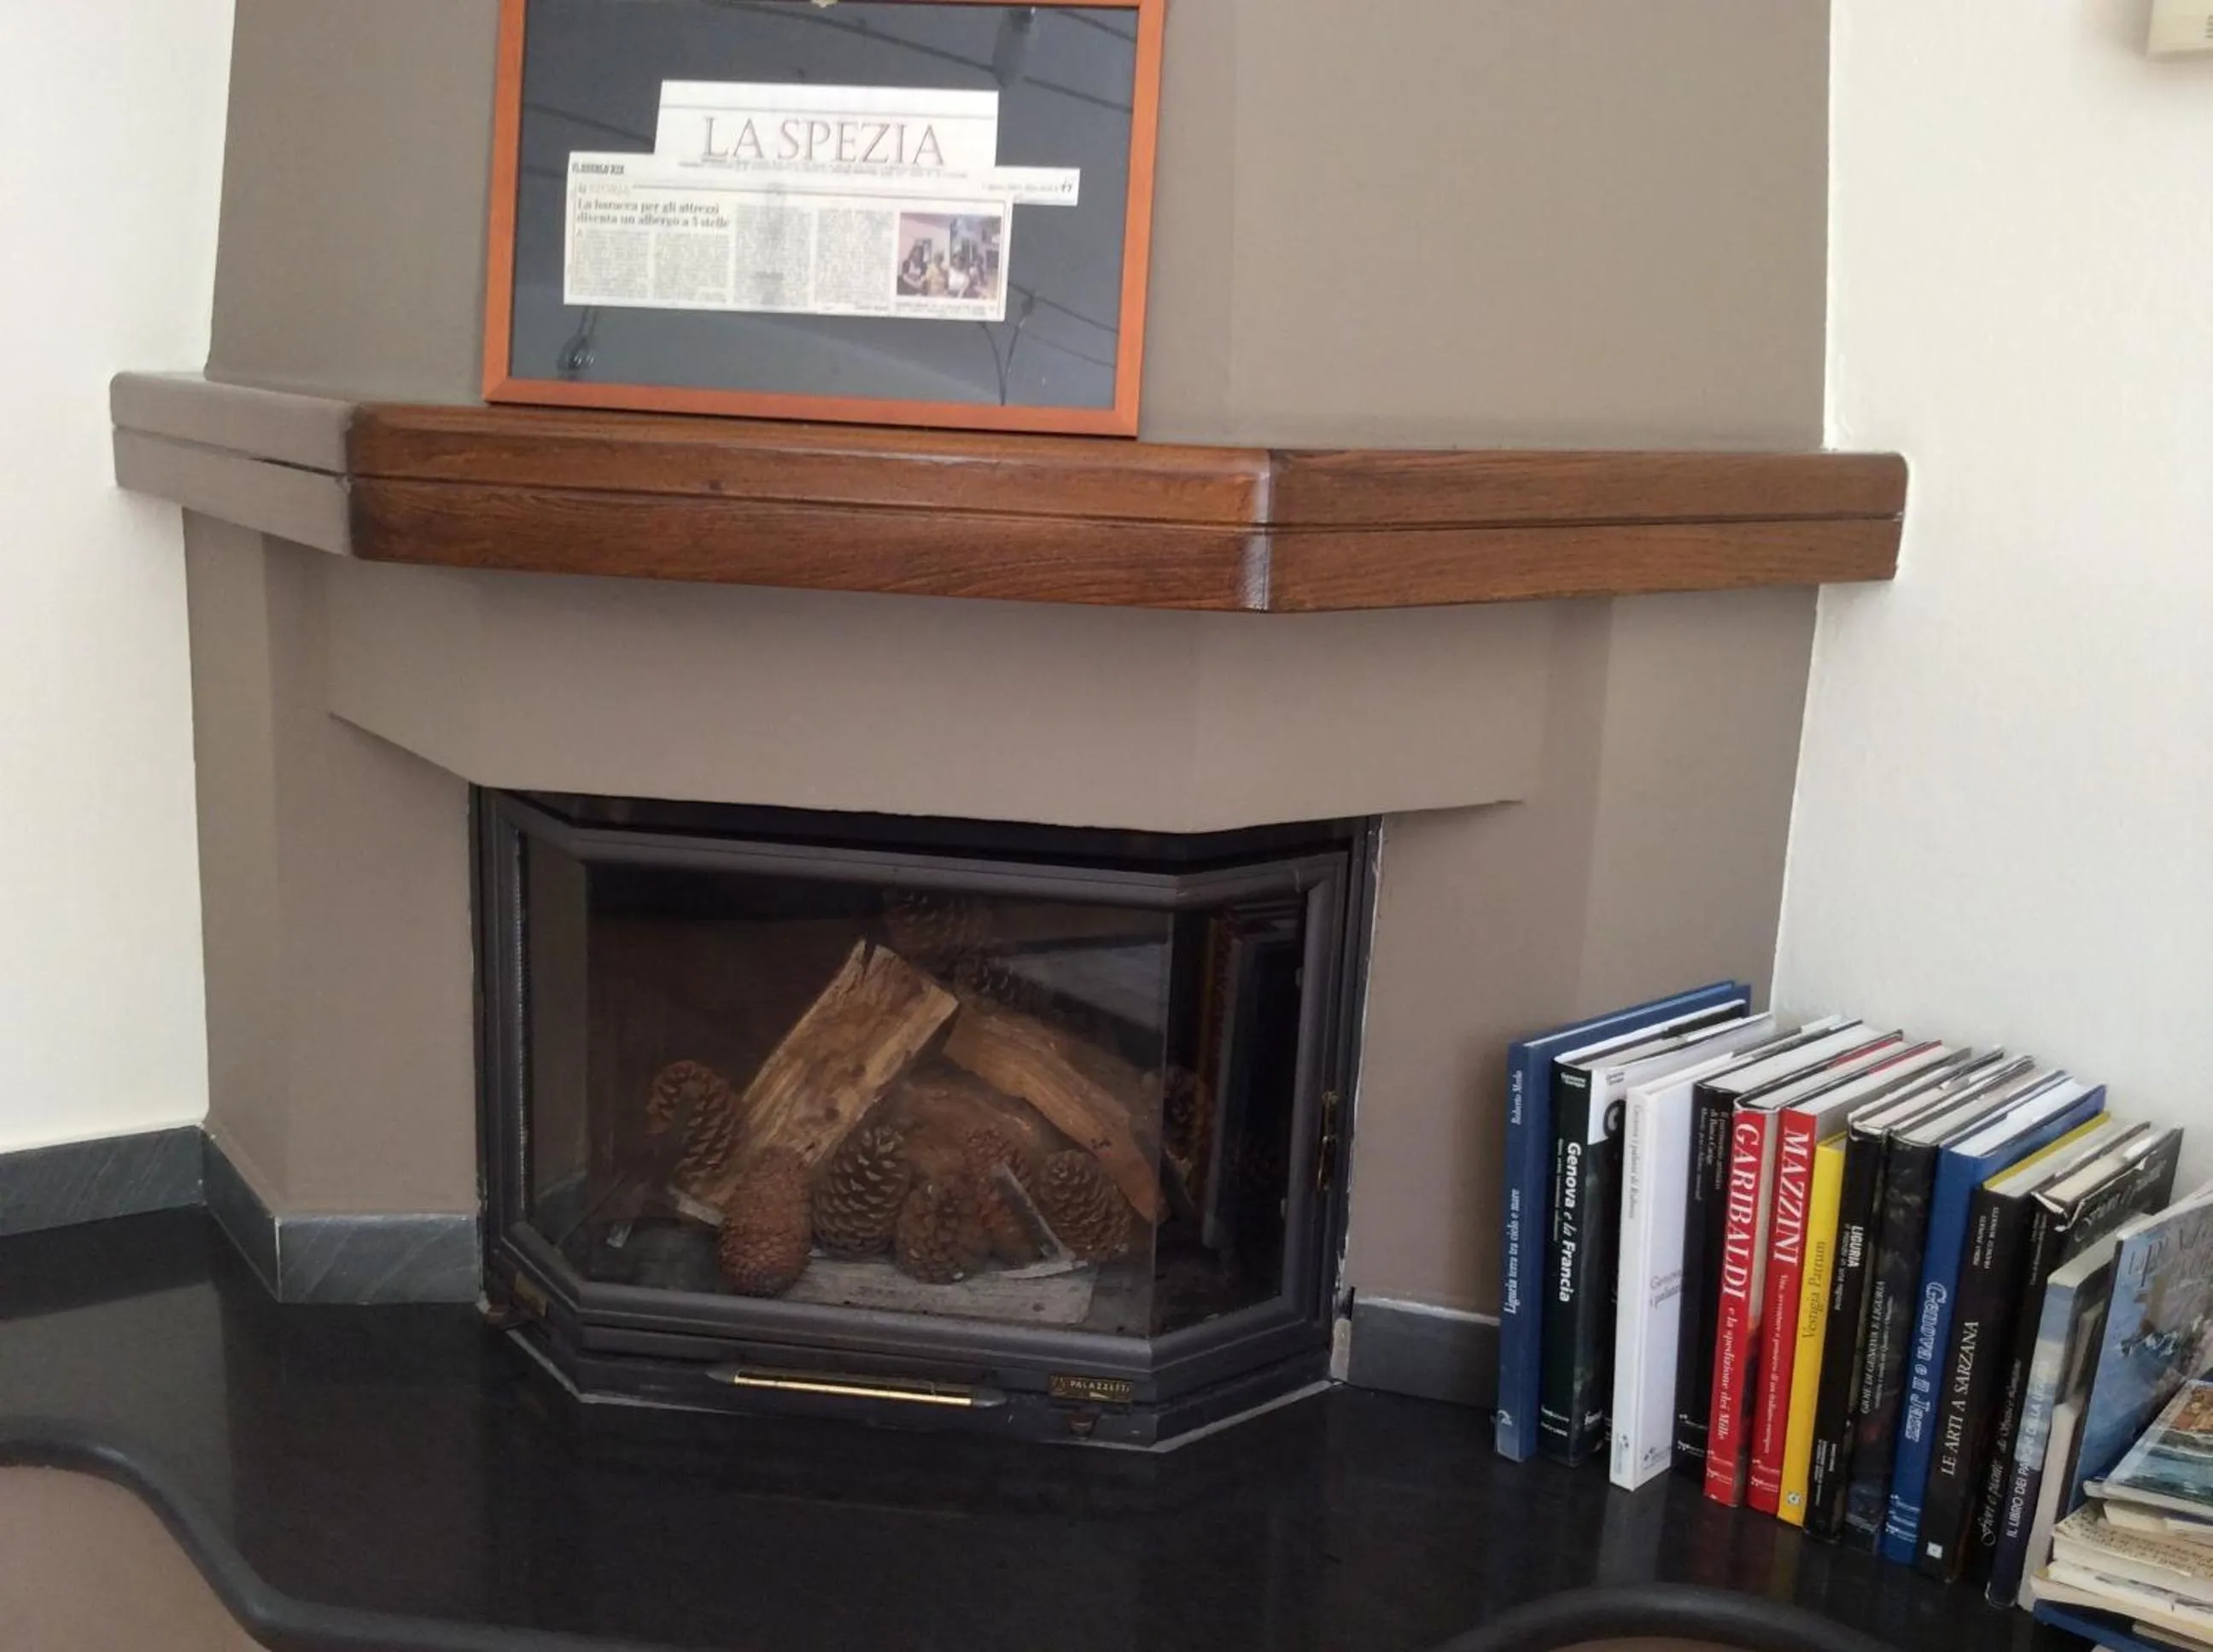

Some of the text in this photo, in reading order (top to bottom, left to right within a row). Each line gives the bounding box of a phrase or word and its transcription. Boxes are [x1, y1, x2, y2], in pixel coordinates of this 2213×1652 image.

[702, 116, 944, 166] LA SPEZIA
[620, 214, 635, 225] un
[638, 213, 680, 227] albergo
[1564, 1142, 1582, 1208] Genova
[1773, 1129, 1810, 1267] MAZZINI
[1722, 1123, 1760, 1301] GARIBALDI
[1847, 1225, 1864, 1268] LIGURIA
[1559, 1240, 1577, 1303] Francia
[1504, 1278, 1521, 1314] Liguria
[1725, 1316, 1737, 1328] la
[1917, 1281, 1948, 1361] Genova
[1721, 1329, 1737, 1389] spedizione
[1914, 1364, 1928, 1375] e
[1941, 1322, 1980, 1476] LE ARTI A SARZANA
[2014, 1479, 2028, 1495] DEI
[2006, 1529, 2018, 1538] IL
[2009, 1497, 2024, 1528] LIBRO
